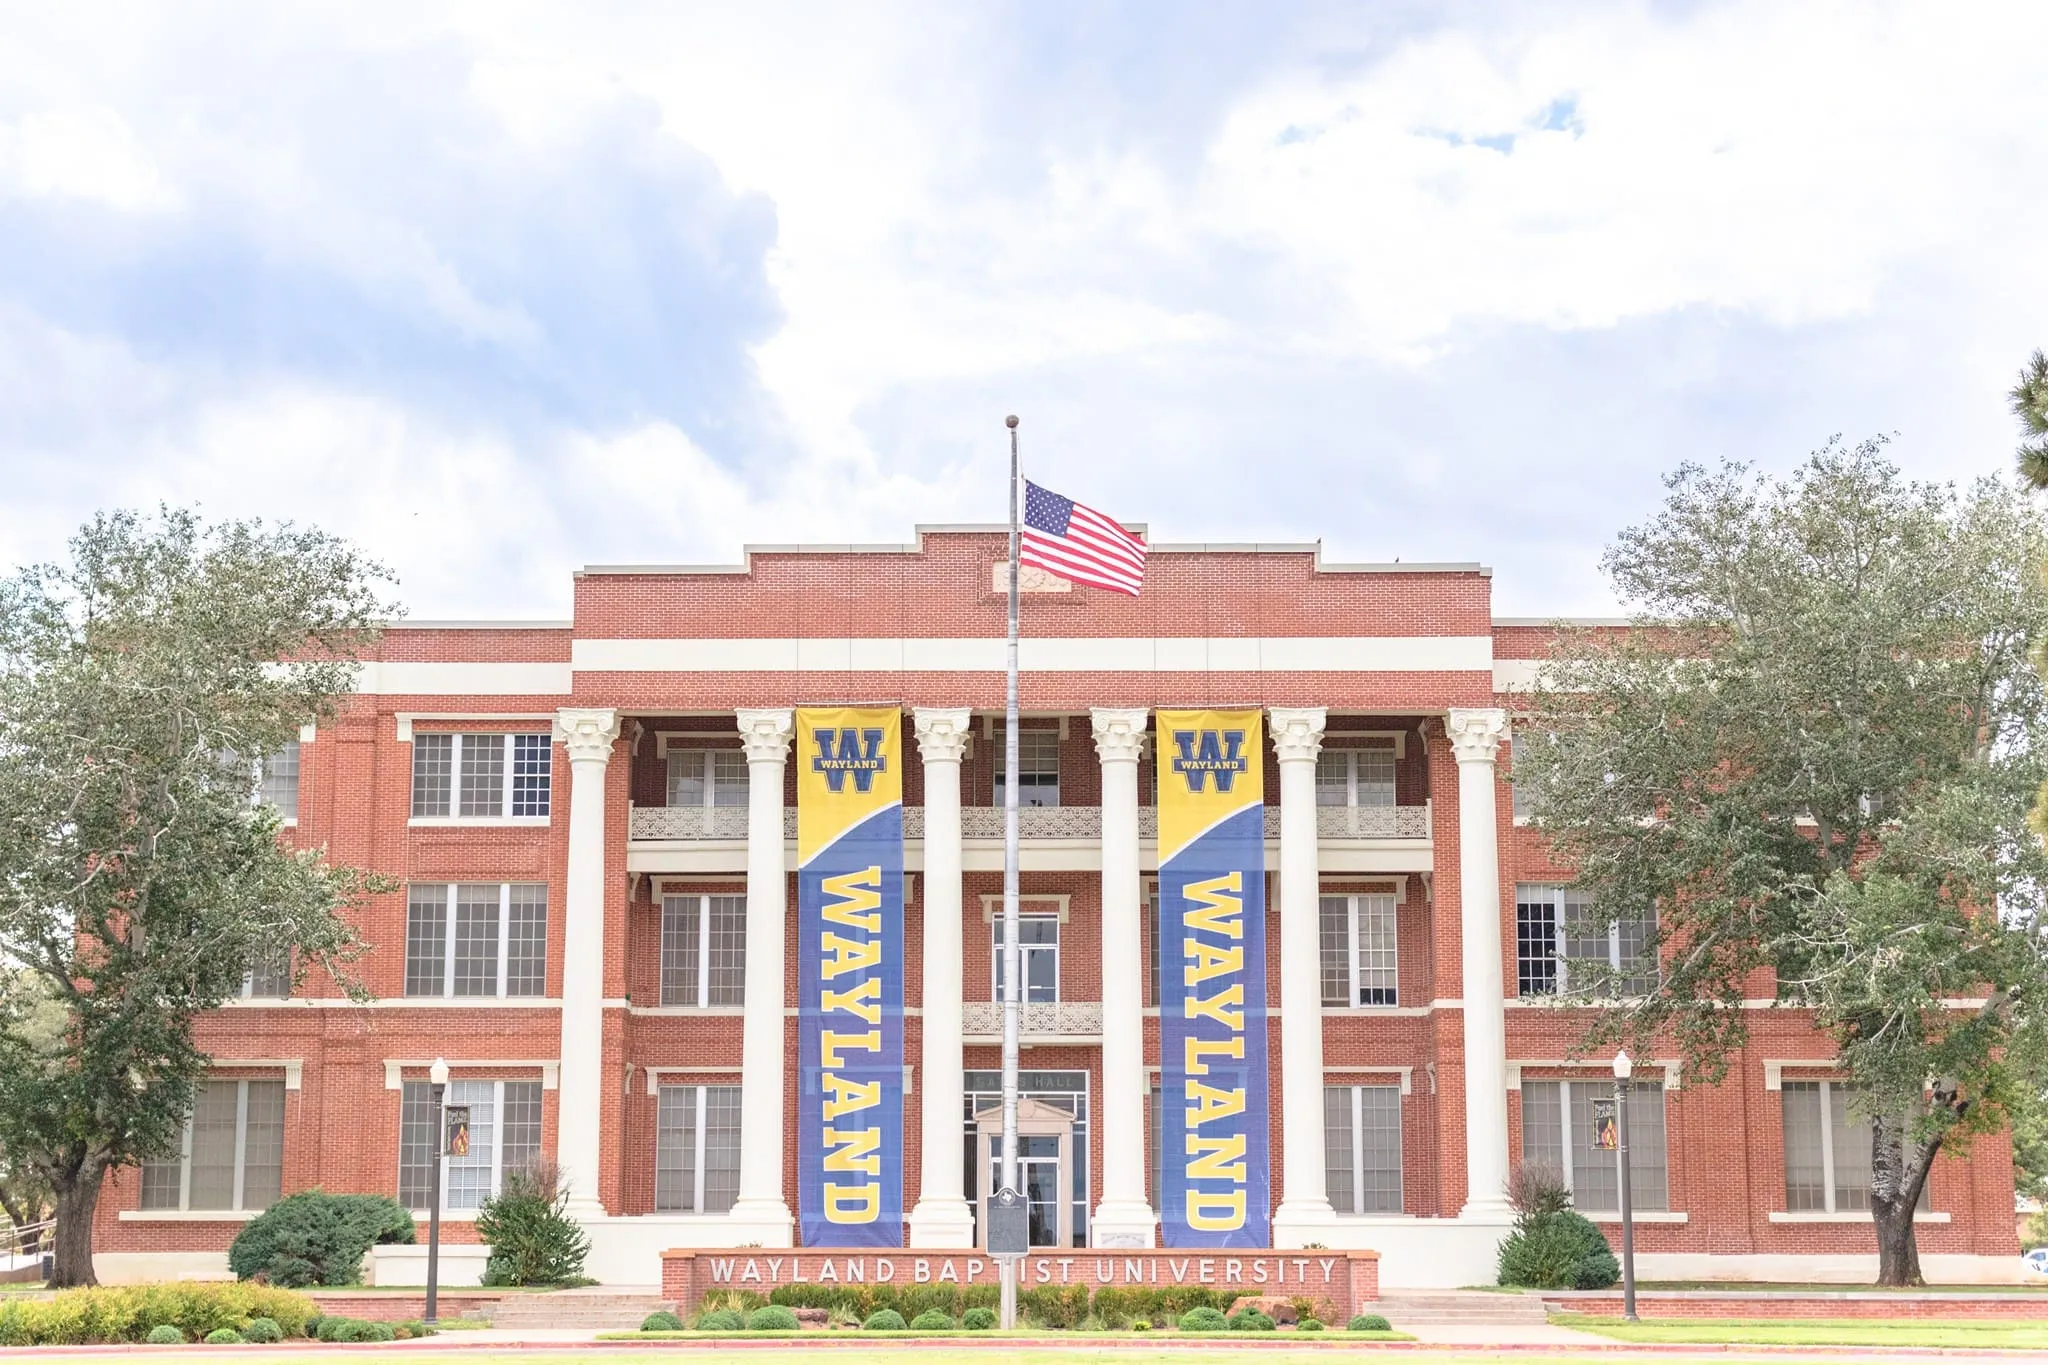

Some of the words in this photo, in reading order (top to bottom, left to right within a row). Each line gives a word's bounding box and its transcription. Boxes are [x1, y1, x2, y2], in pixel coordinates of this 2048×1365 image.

[812, 727, 885, 794] W
[820, 759, 878, 769] WAYLAND
[1172, 729, 1246, 794] W
[1180, 760, 1239, 770] WAYLAND
[820, 865, 882, 1225] WAYLAND
[1182, 871, 1247, 1232] WAYLAND
[1035, 1076, 1073, 1088] HALL
[710, 1258, 896, 1283] WAYLAND
[1096, 1258, 1336, 1284] UNIVERSITY
